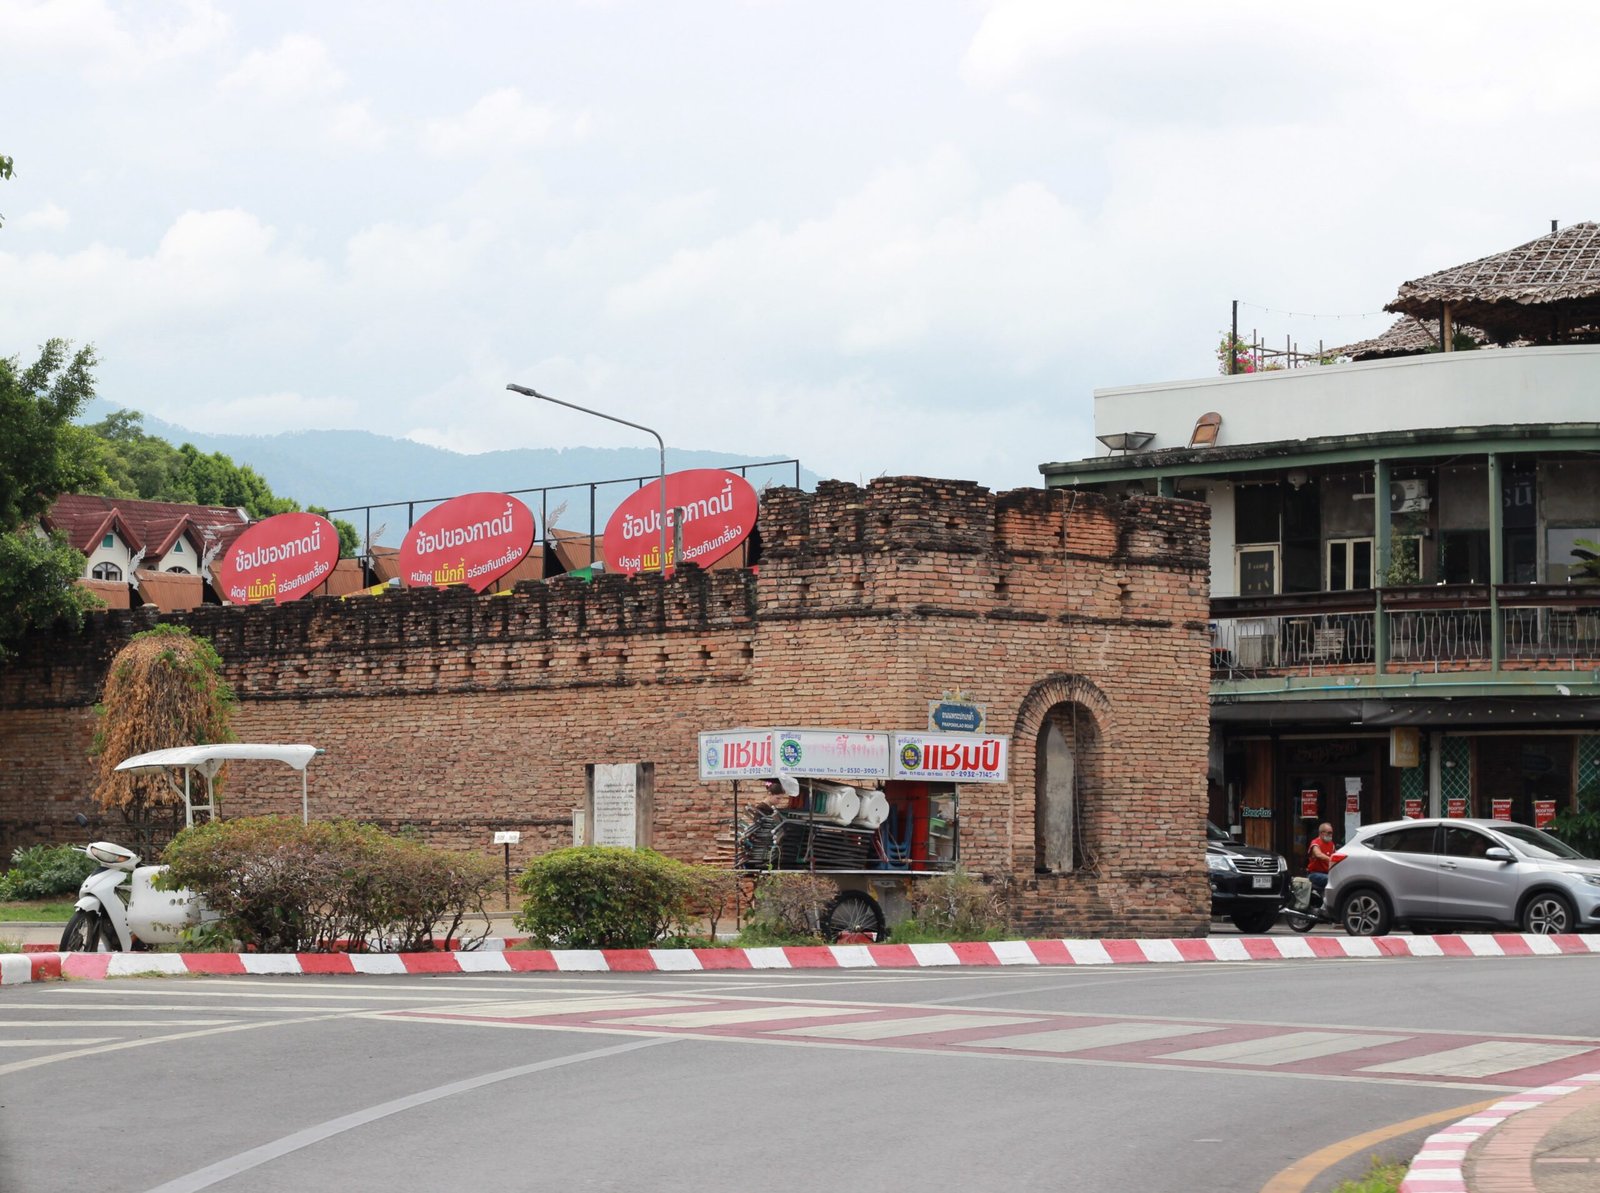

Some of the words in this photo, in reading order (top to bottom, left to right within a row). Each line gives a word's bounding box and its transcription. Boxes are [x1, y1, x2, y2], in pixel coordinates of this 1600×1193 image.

[236, 521, 321, 572] ช้อปของกาดนี้
[416, 501, 513, 555] ช้อปของกาดนี้
[248, 573, 277, 599] แม็กกี้
[278, 561, 329, 593] อร่อยกินเกลี้ยง
[434, 557, 465, 584] แม็กกี้
[467, 546, 523, 578] อร่อยกินเกลี้ยง
